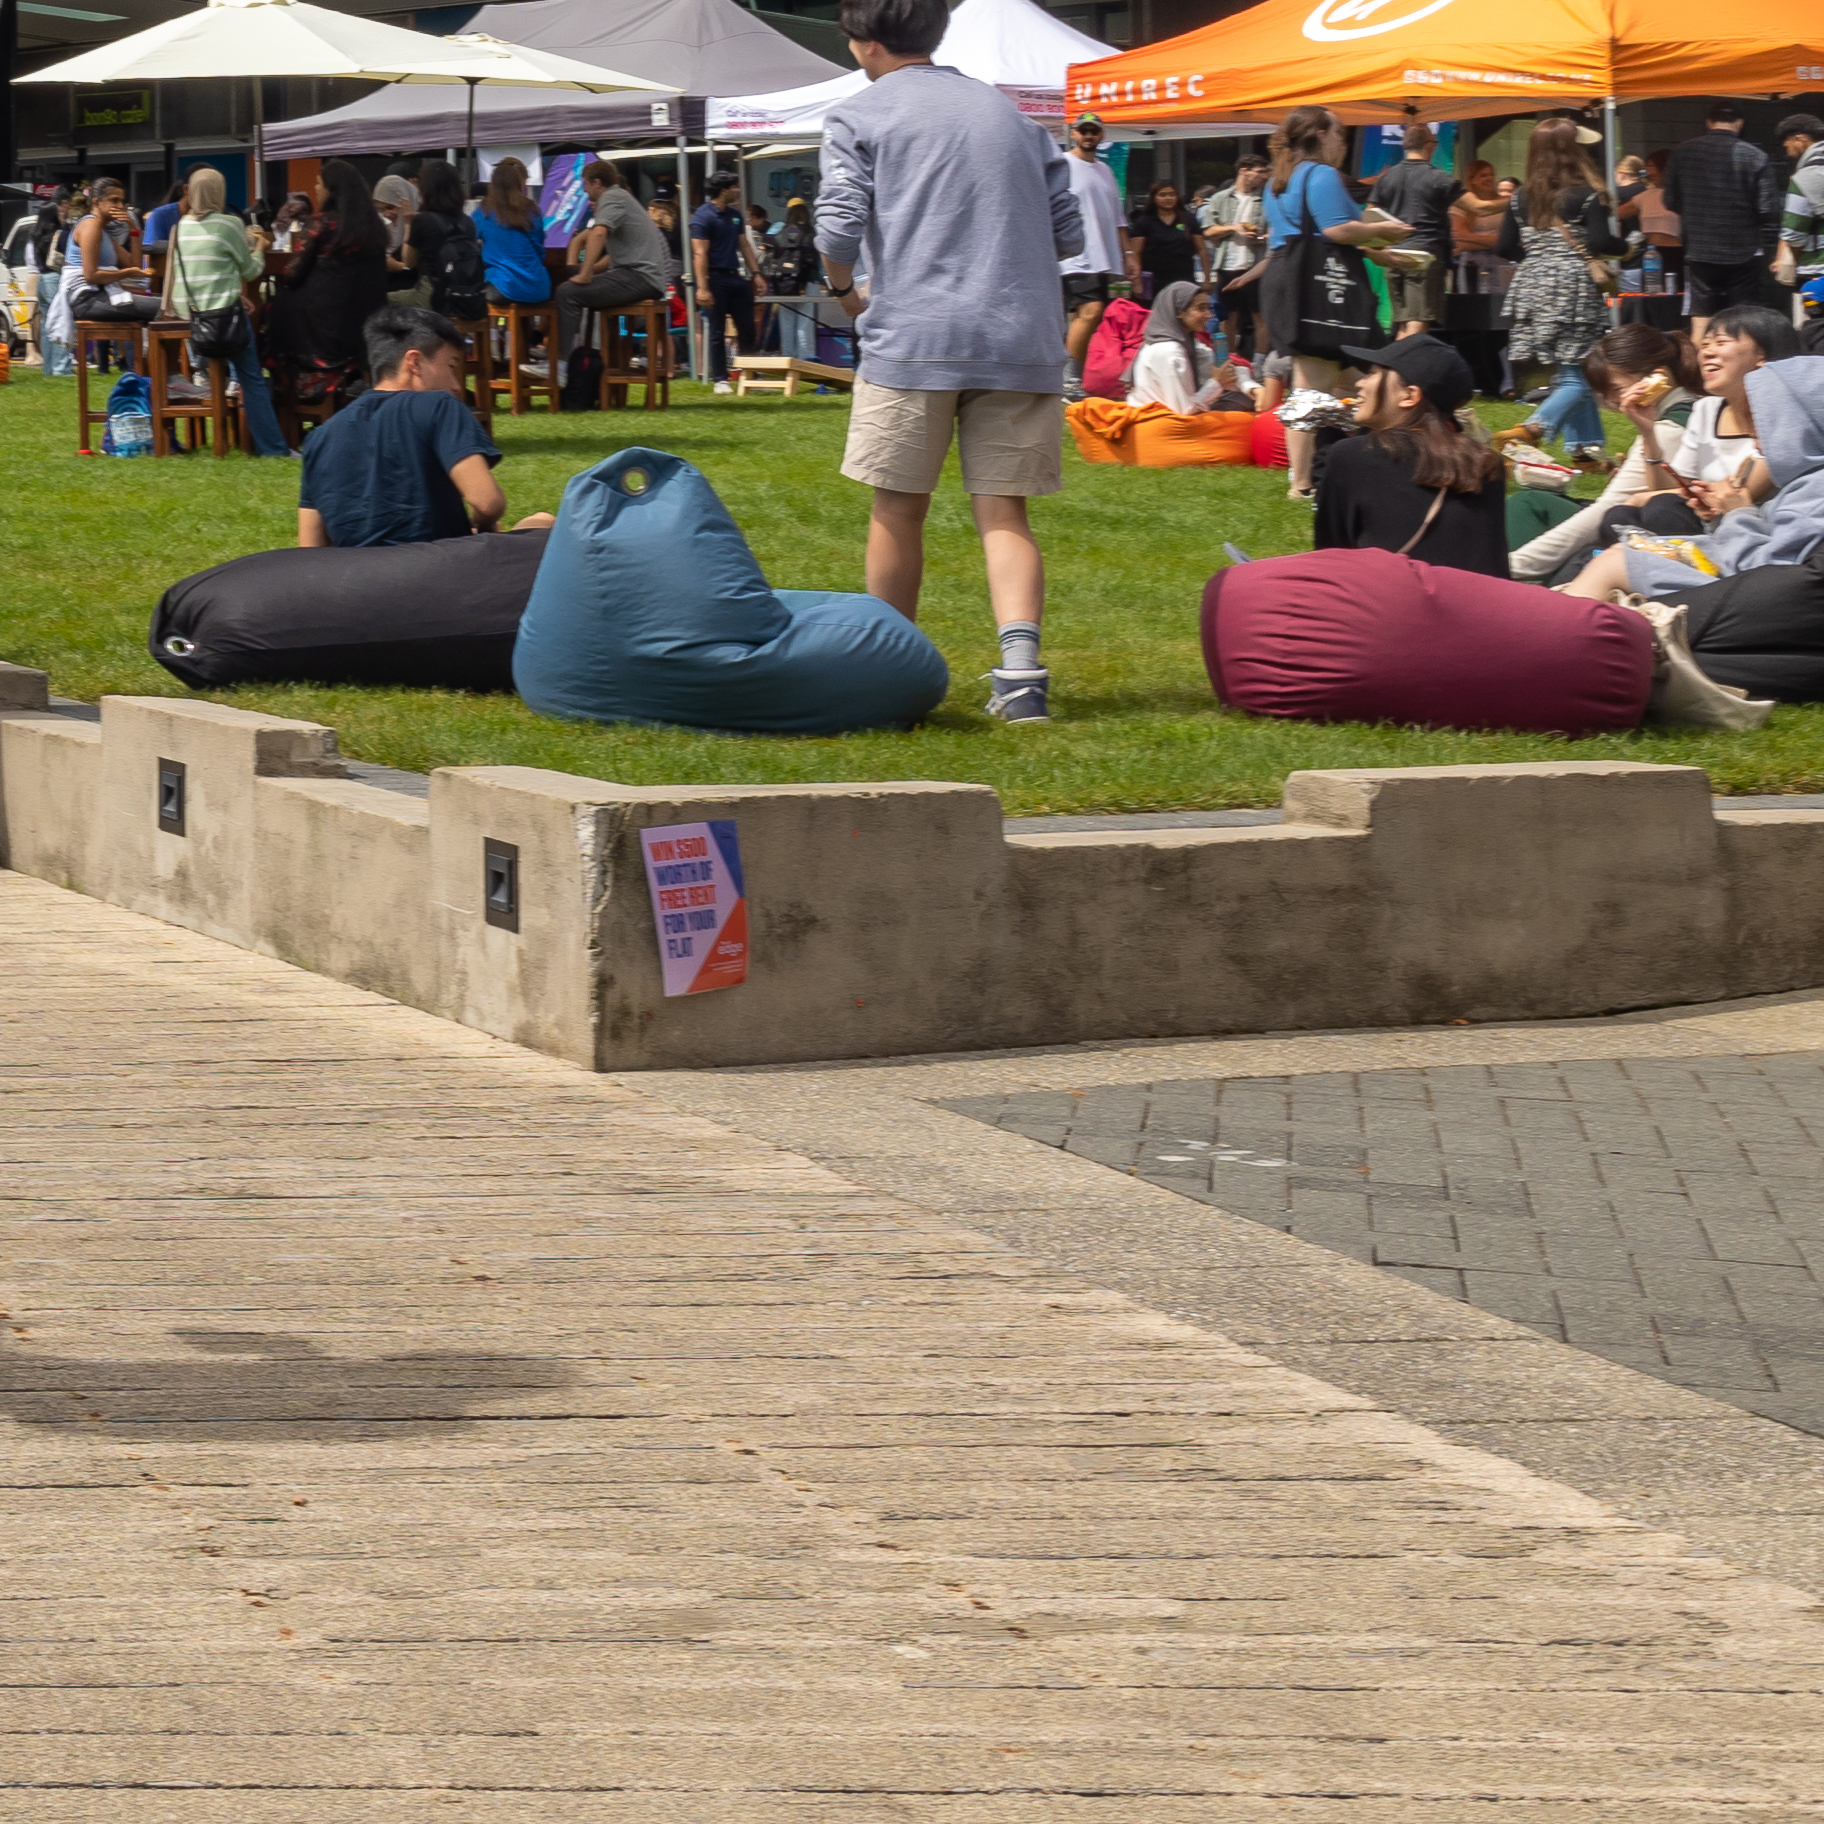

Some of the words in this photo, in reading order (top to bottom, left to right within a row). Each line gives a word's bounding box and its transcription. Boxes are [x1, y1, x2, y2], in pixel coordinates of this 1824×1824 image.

[1074, 74, 1205, 105] UNIREC
[648, 840, 675, 863] WIN
[653, 862, 698, 886] WORTH
[698, 860, 714, 882] OF
[658, 887, 688, 910] FREE
[688, 884, 718, 907] RENT
[662, 912, 687, 935] FOR
[687, 909, 718, 932] YOUR
[666, 937, 694, 960] FLAT
